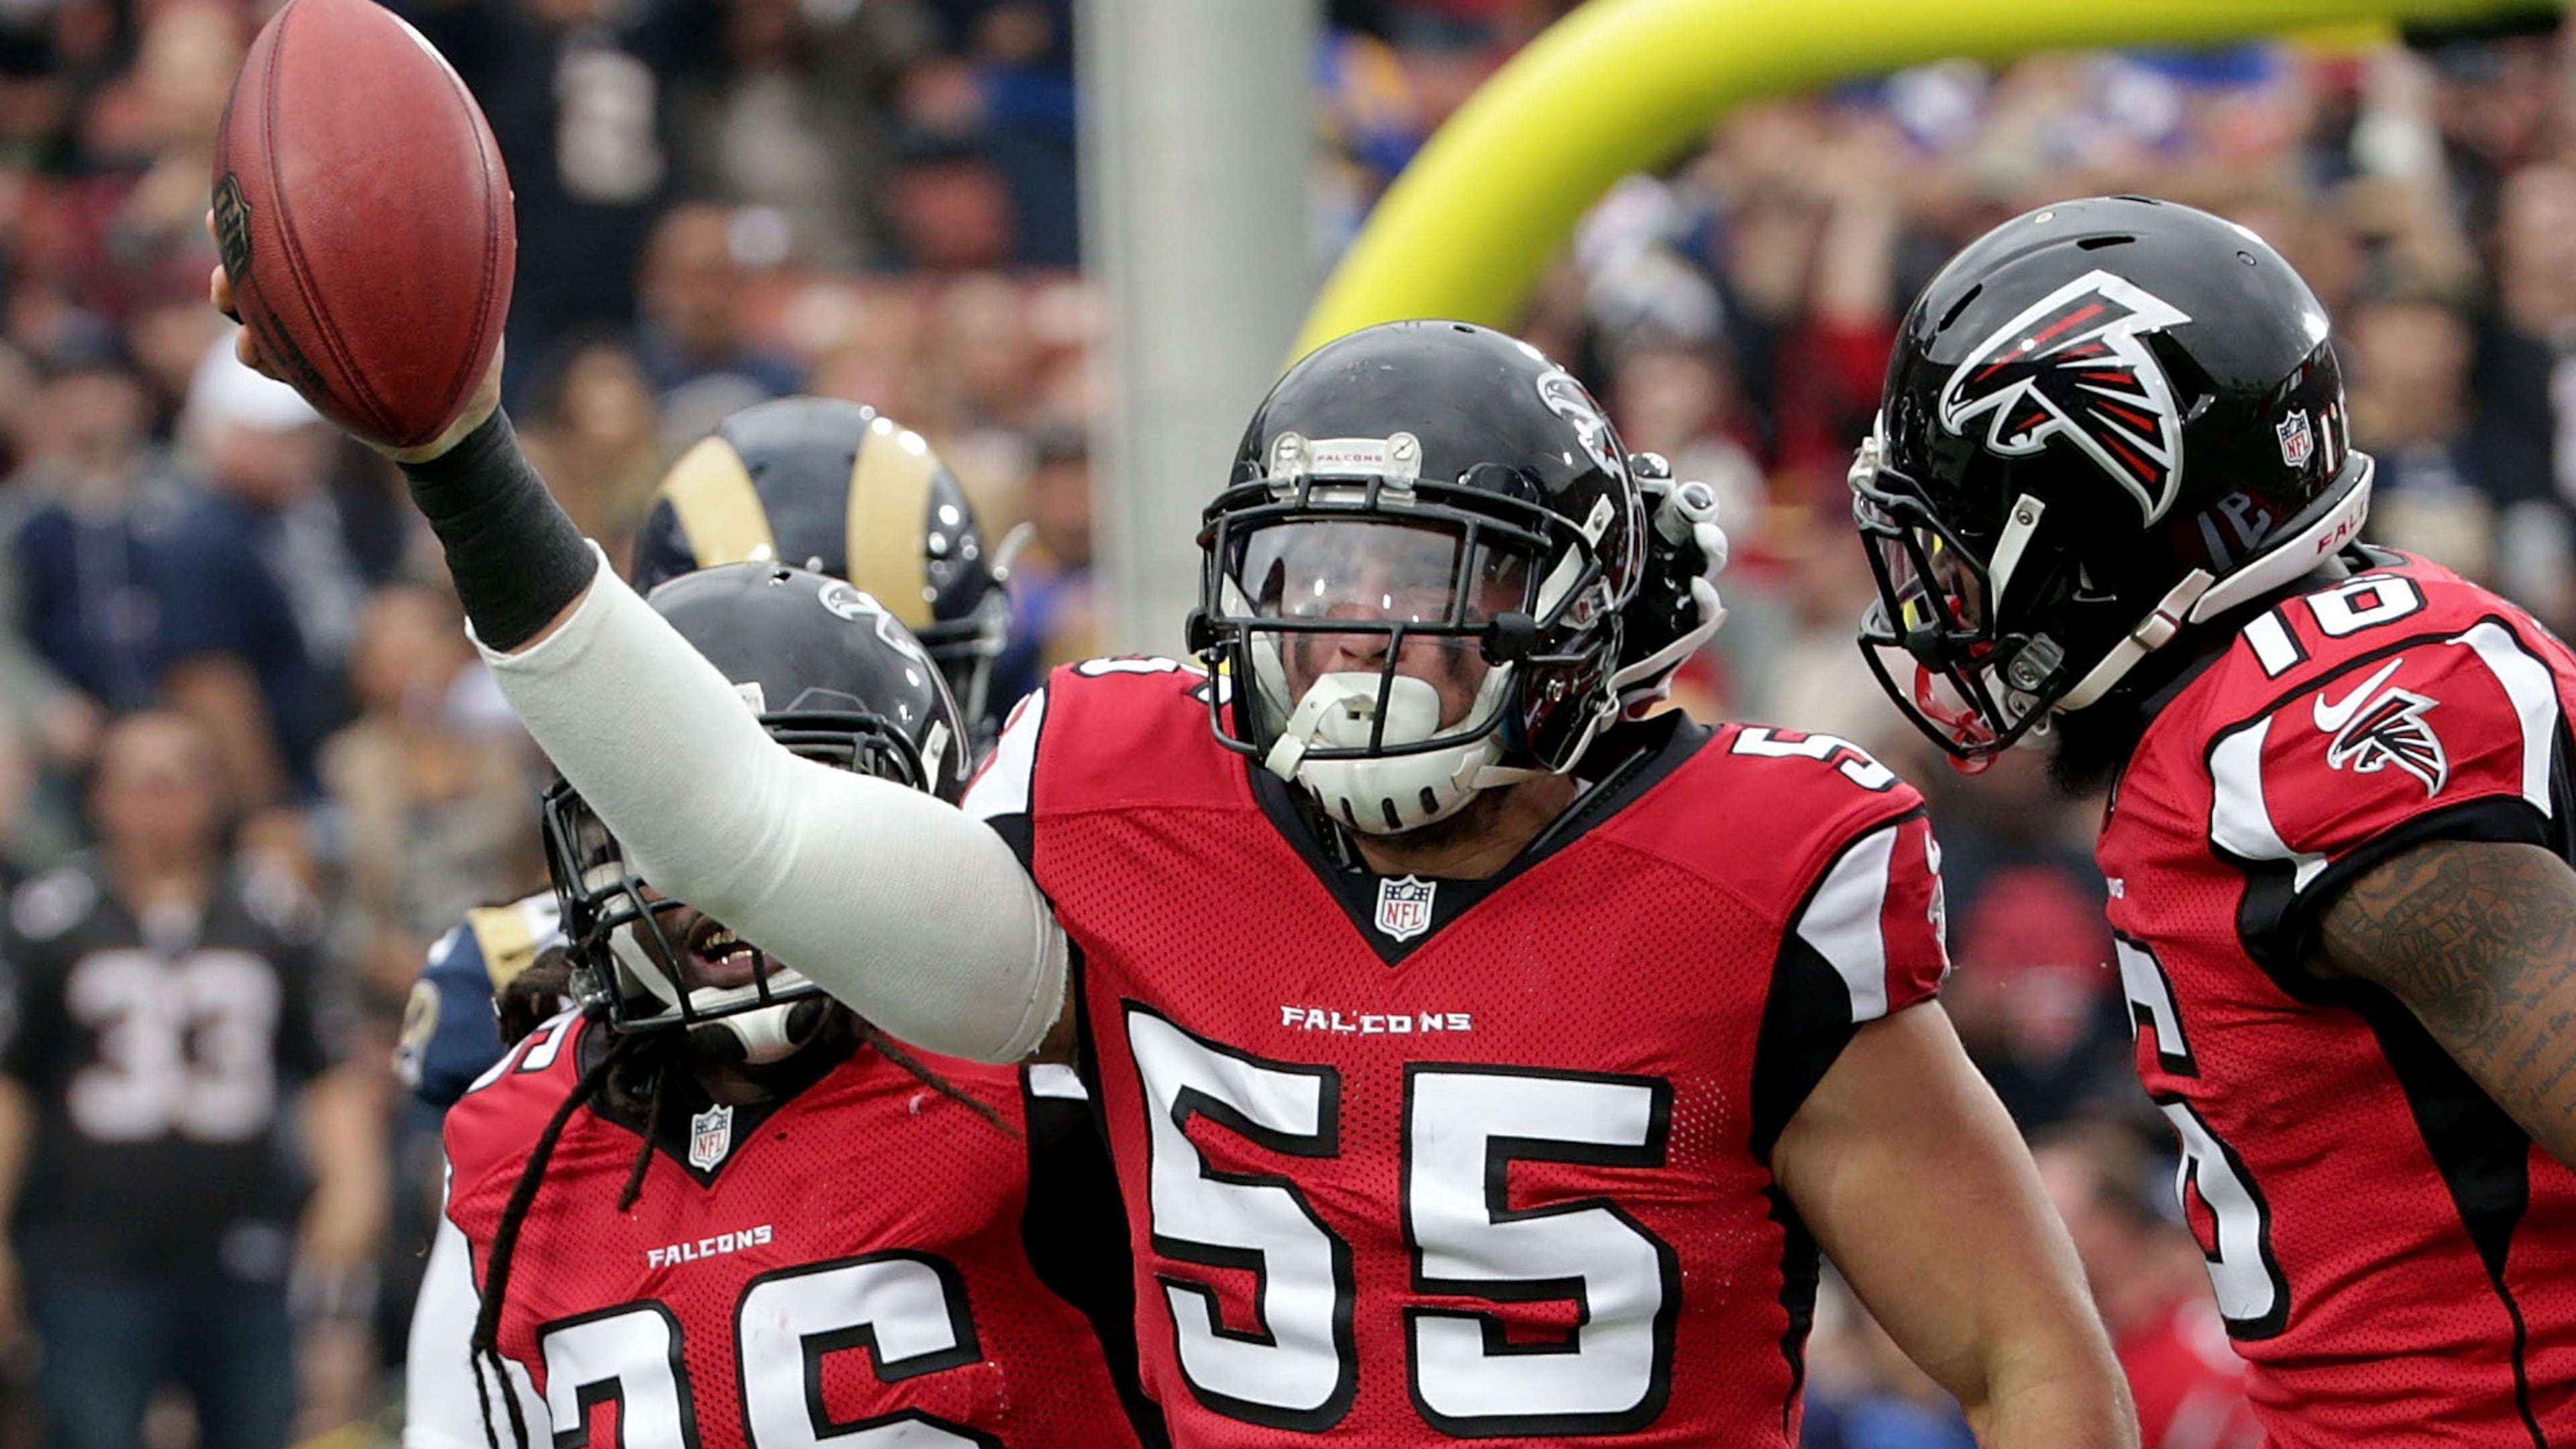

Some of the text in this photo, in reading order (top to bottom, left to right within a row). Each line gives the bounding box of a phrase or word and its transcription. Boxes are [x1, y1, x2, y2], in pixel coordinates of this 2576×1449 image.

[1316, 453, 1383, 462] FALCONS
[2285, 433, 2310, 459] NFL
[1386, 901, 1422, 928] NFL
[1280, 1005, 1472, 1034] FALCONS
[696, 1132, 724, 1158] NFL
[1123, 997, 1681, 1437] 55
[647, 1224, 773, 1269] FALCONS
